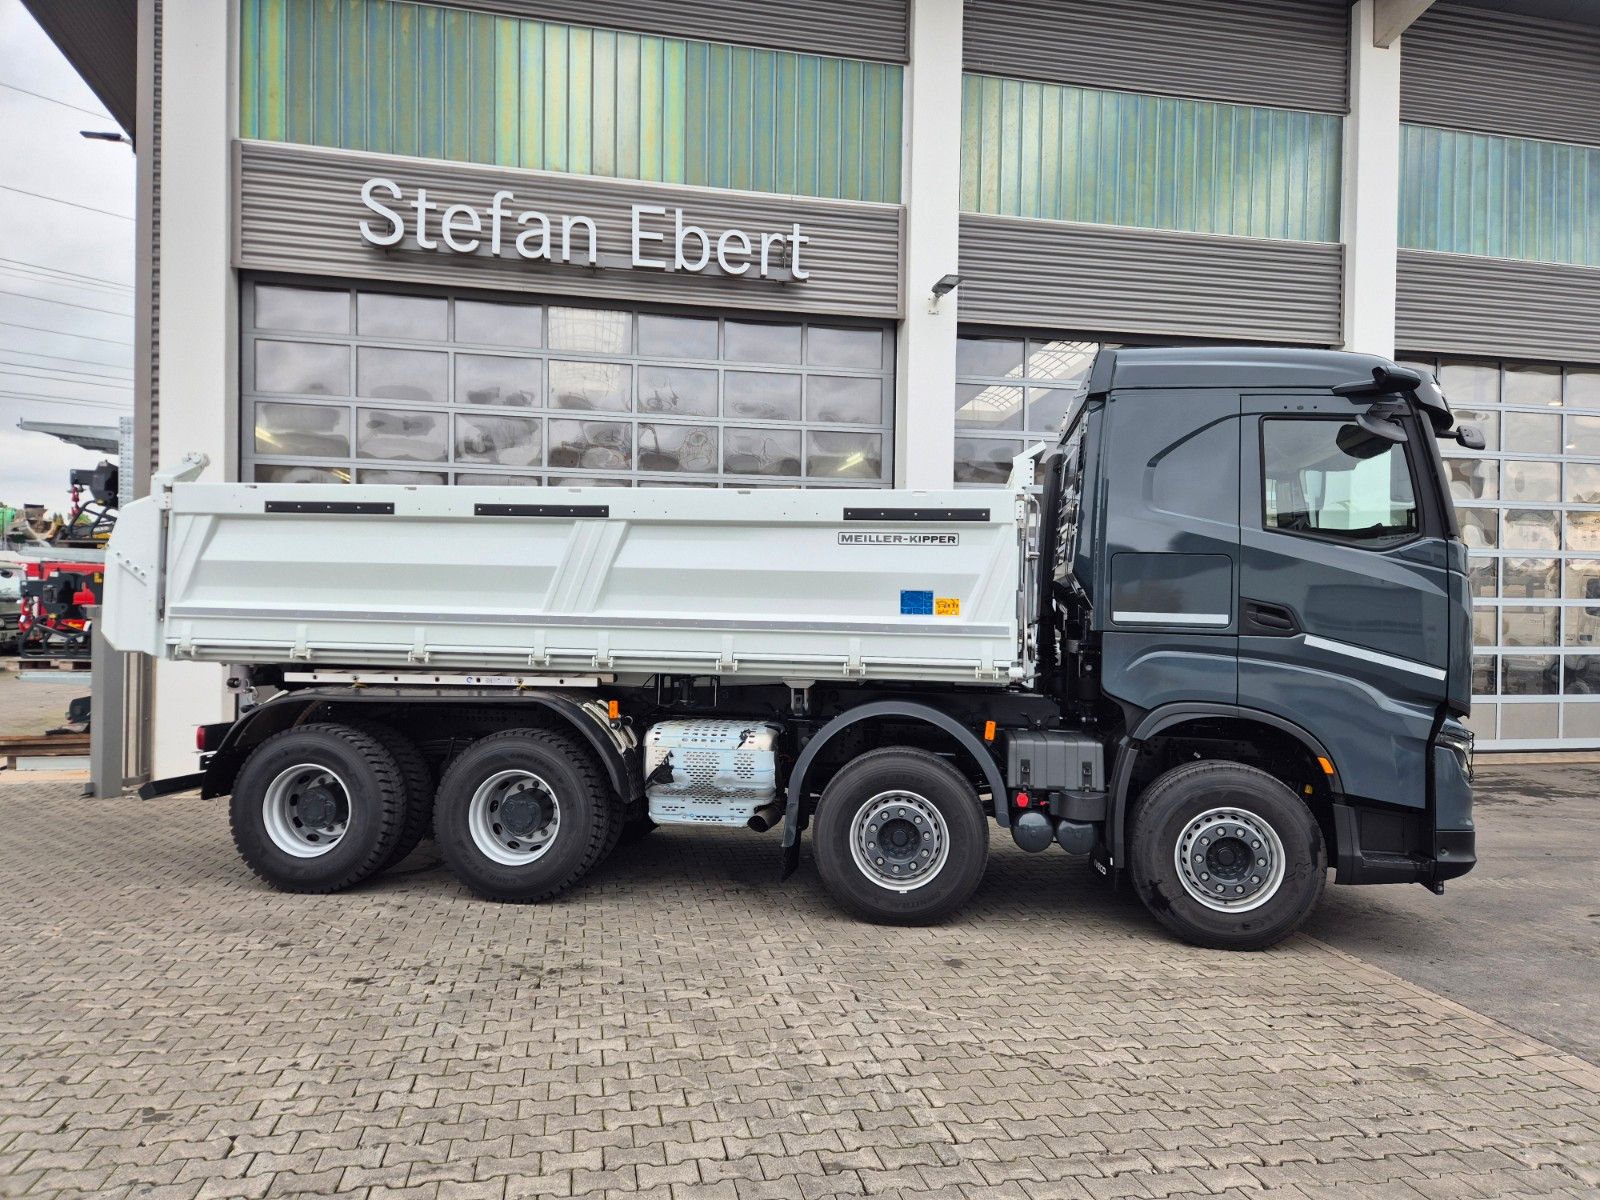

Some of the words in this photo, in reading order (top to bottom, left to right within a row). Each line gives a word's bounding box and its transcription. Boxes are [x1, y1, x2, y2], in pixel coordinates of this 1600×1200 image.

[359, 177, 597, 264] Stefan
[631, 203, 810, 279] Ebert
[841, 534, 957, 544] MEILLER-KIPPER
